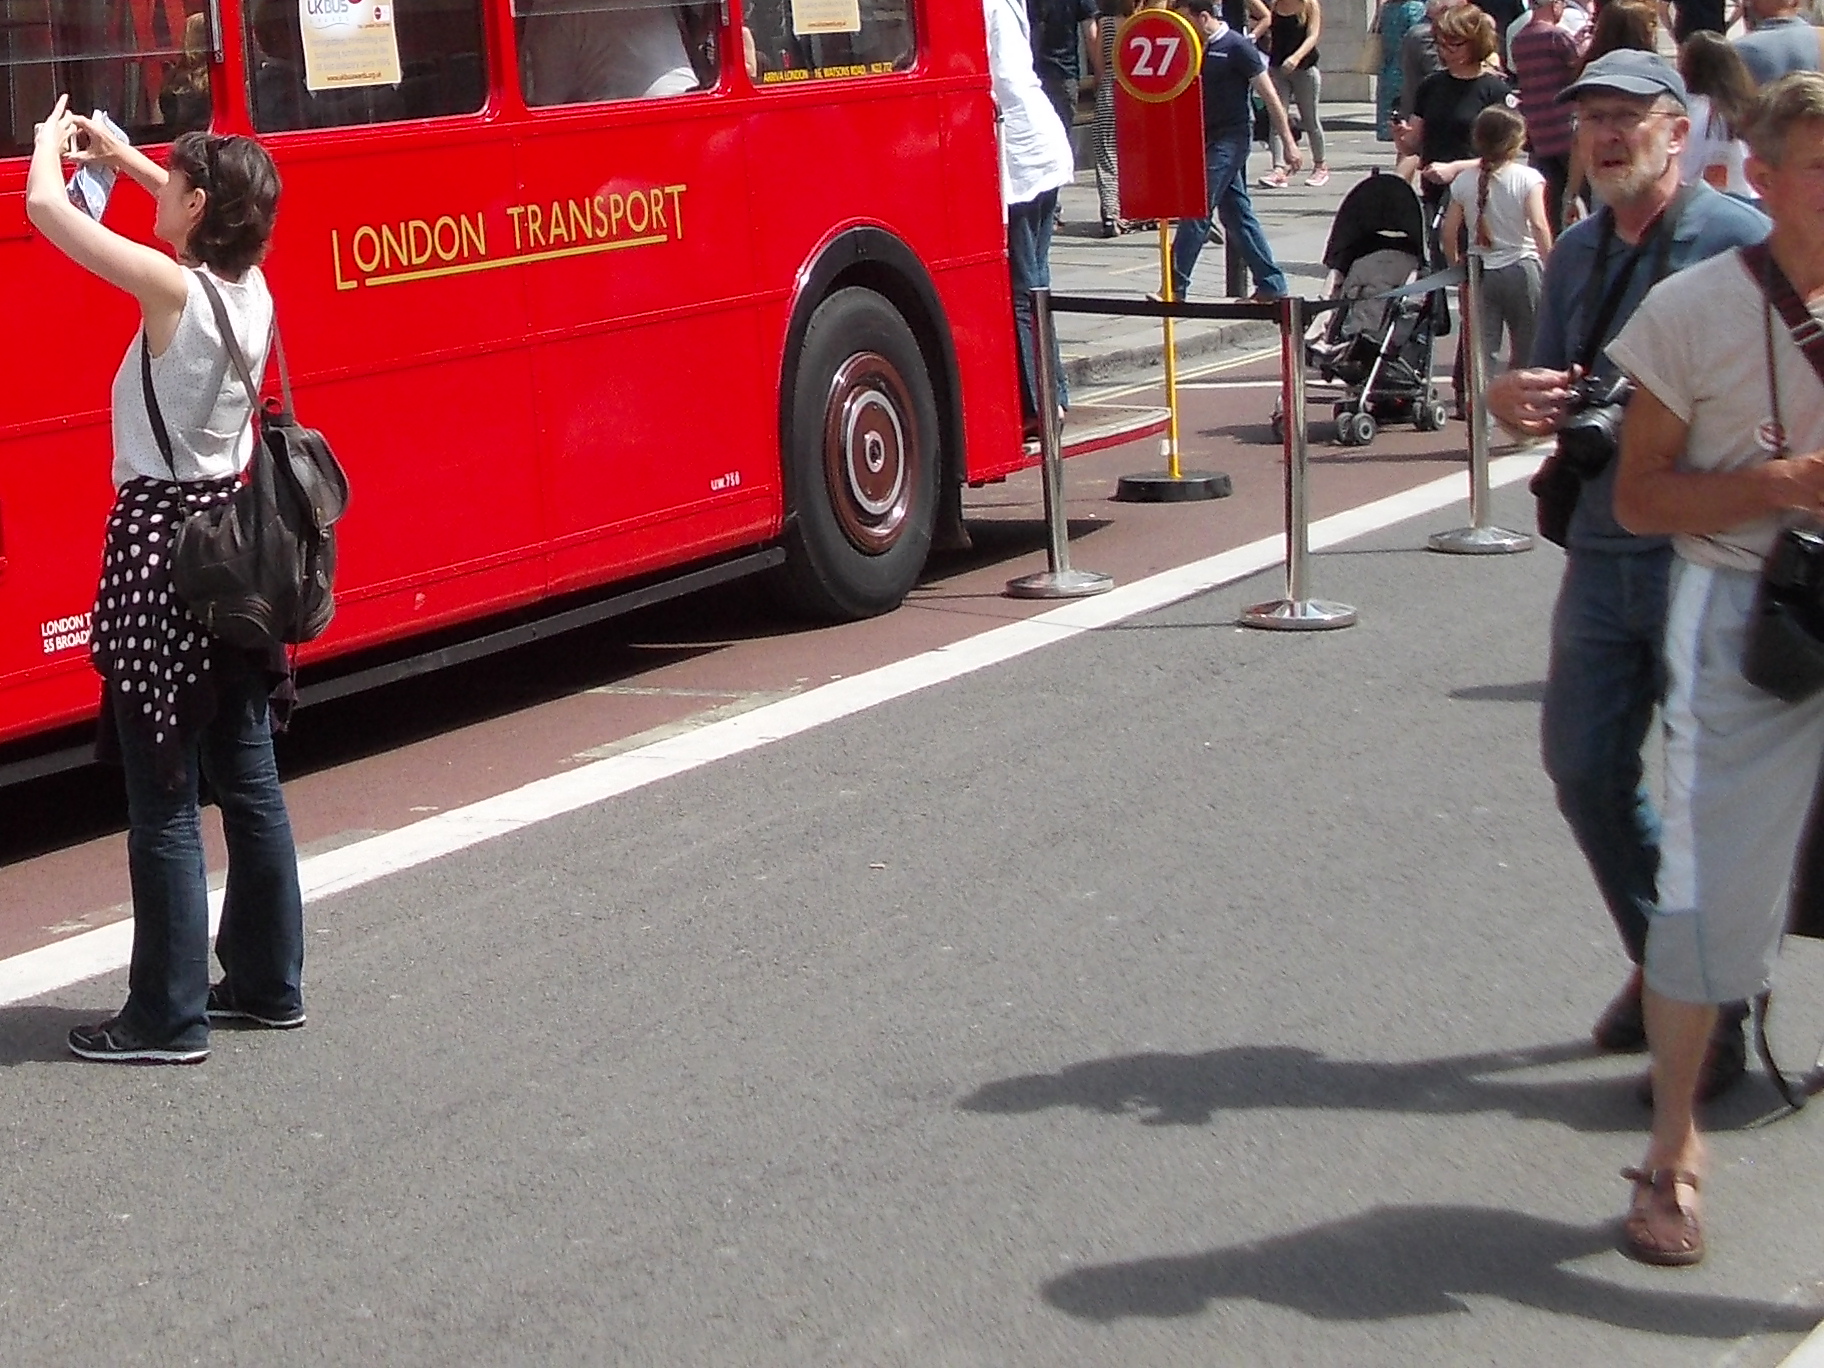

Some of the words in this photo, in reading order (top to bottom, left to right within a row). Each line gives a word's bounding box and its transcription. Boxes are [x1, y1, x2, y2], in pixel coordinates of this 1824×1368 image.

[1129, 36, 1180, 76] 27
[331, 211, 486, 290] LONDON
[506, 184, 687, 250] TRANSPORT
[41, 614, 83, 637] LONDON
[84, 612, 92, 627] T
[43, 638, 55, 653] 55
